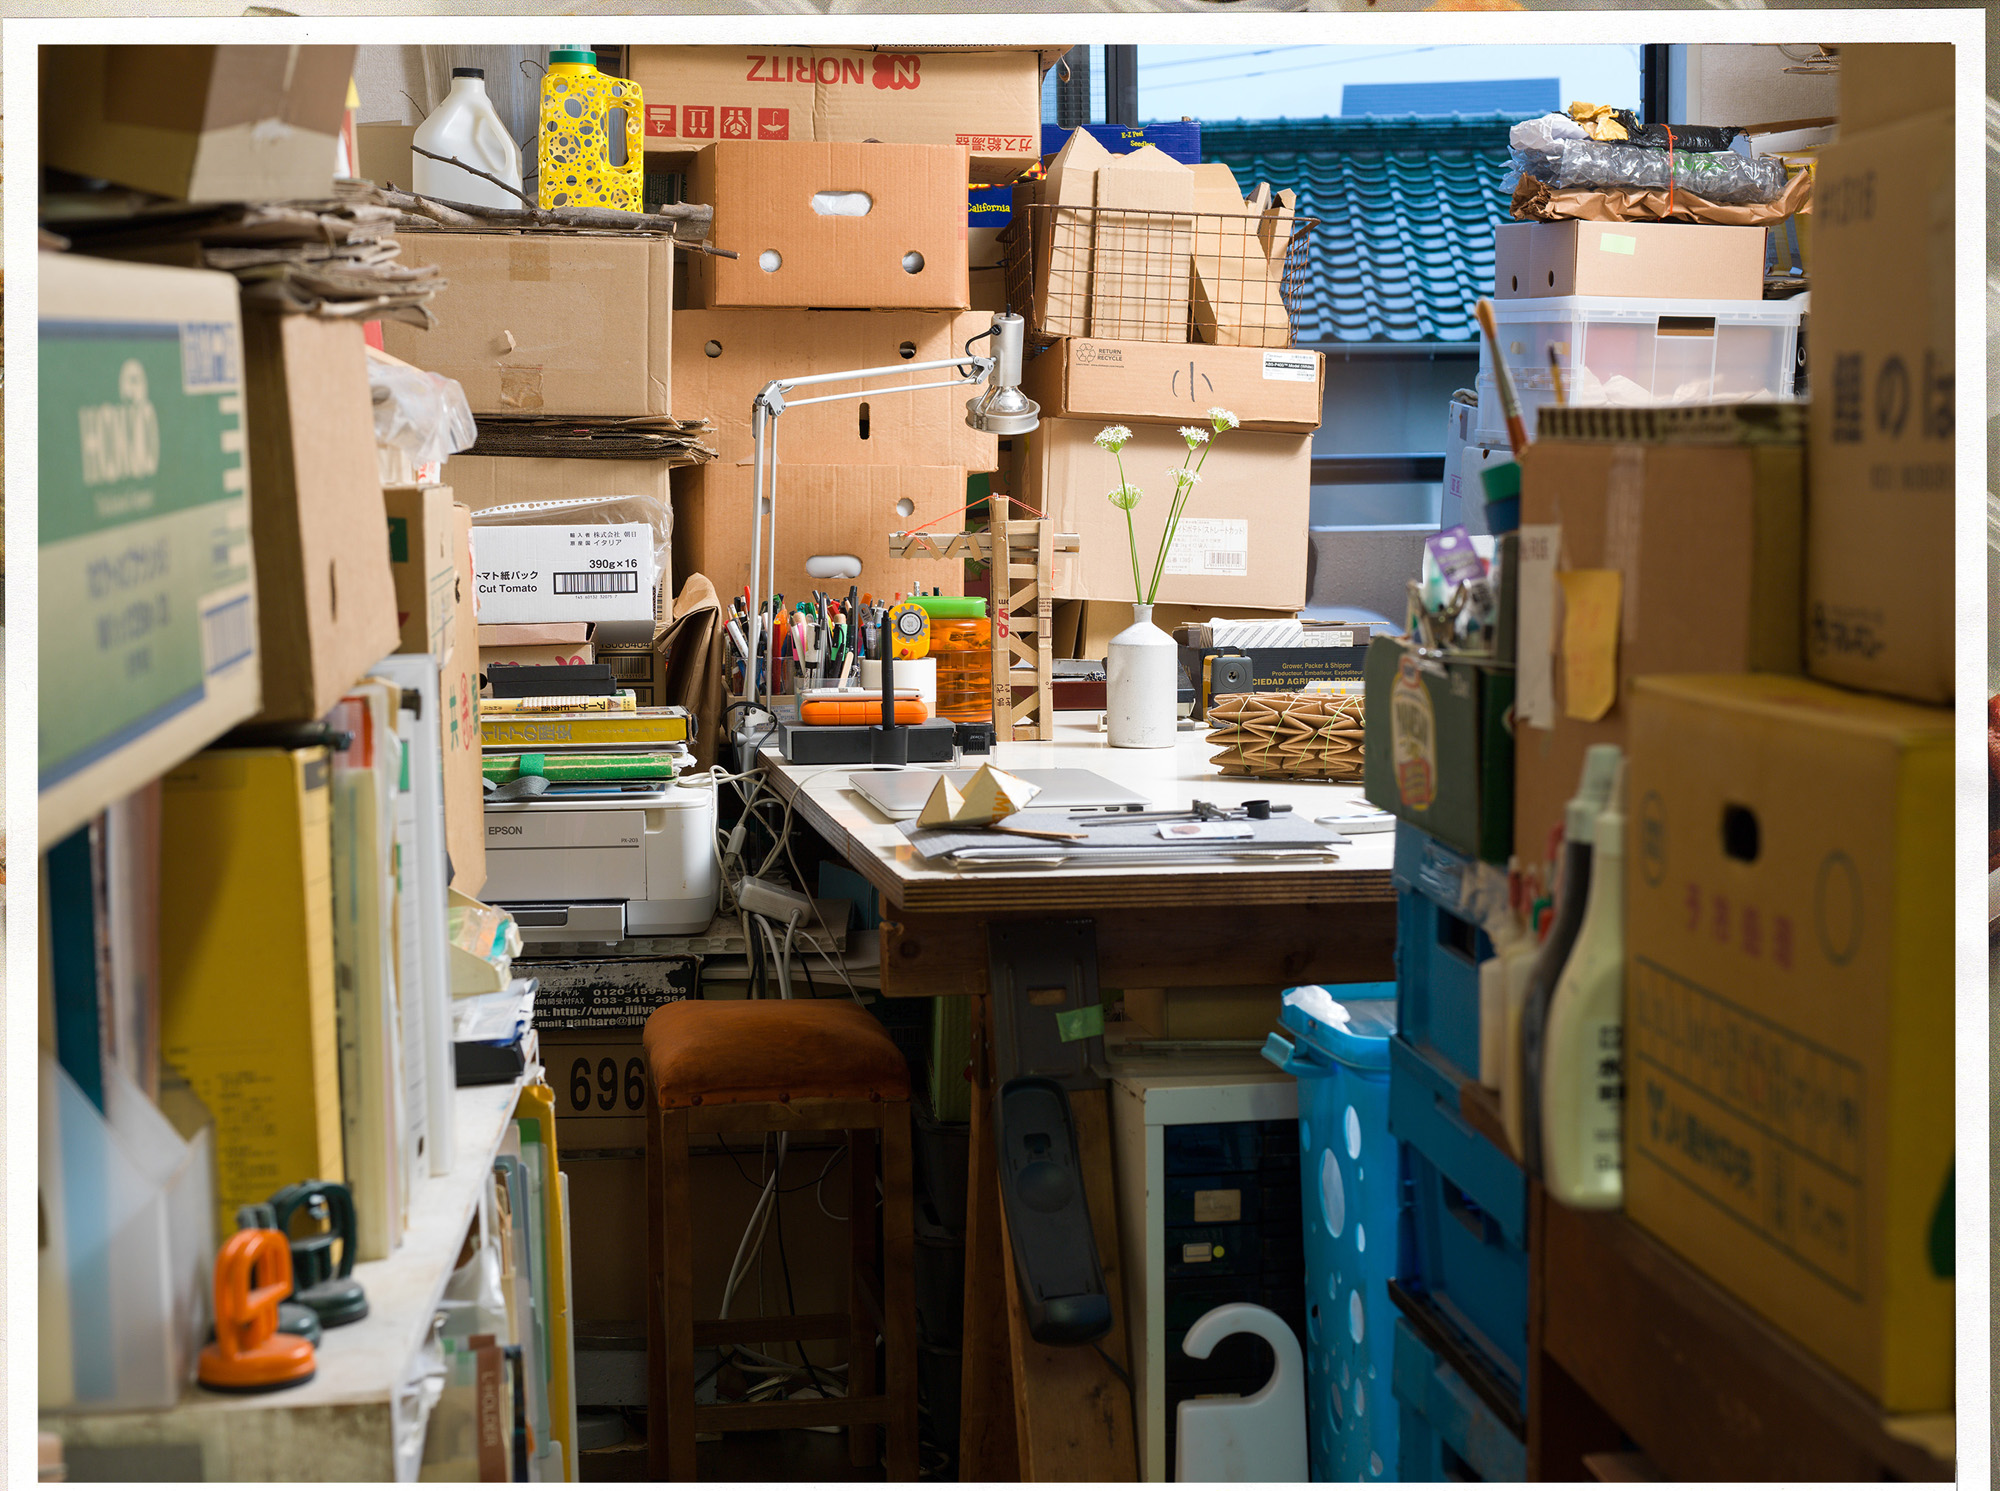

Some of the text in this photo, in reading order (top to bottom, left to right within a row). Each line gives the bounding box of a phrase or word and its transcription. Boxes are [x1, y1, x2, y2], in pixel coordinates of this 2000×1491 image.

[746, 55, 864, 84] NORITZ
[967, 202, 1010, 213] California
[589, 559, 638, 570] 390g×16
[478, 584, 538, 593] Cut Tomato
[1281, 662, 1304, 670] Grower,
[488, 826, 523, 835] EPSON
[593, 987, 687, 997] 0120-159-889
[593, 996, 687, 1005] 093-341-2964
[570, 1057, 645, 1112] 696
